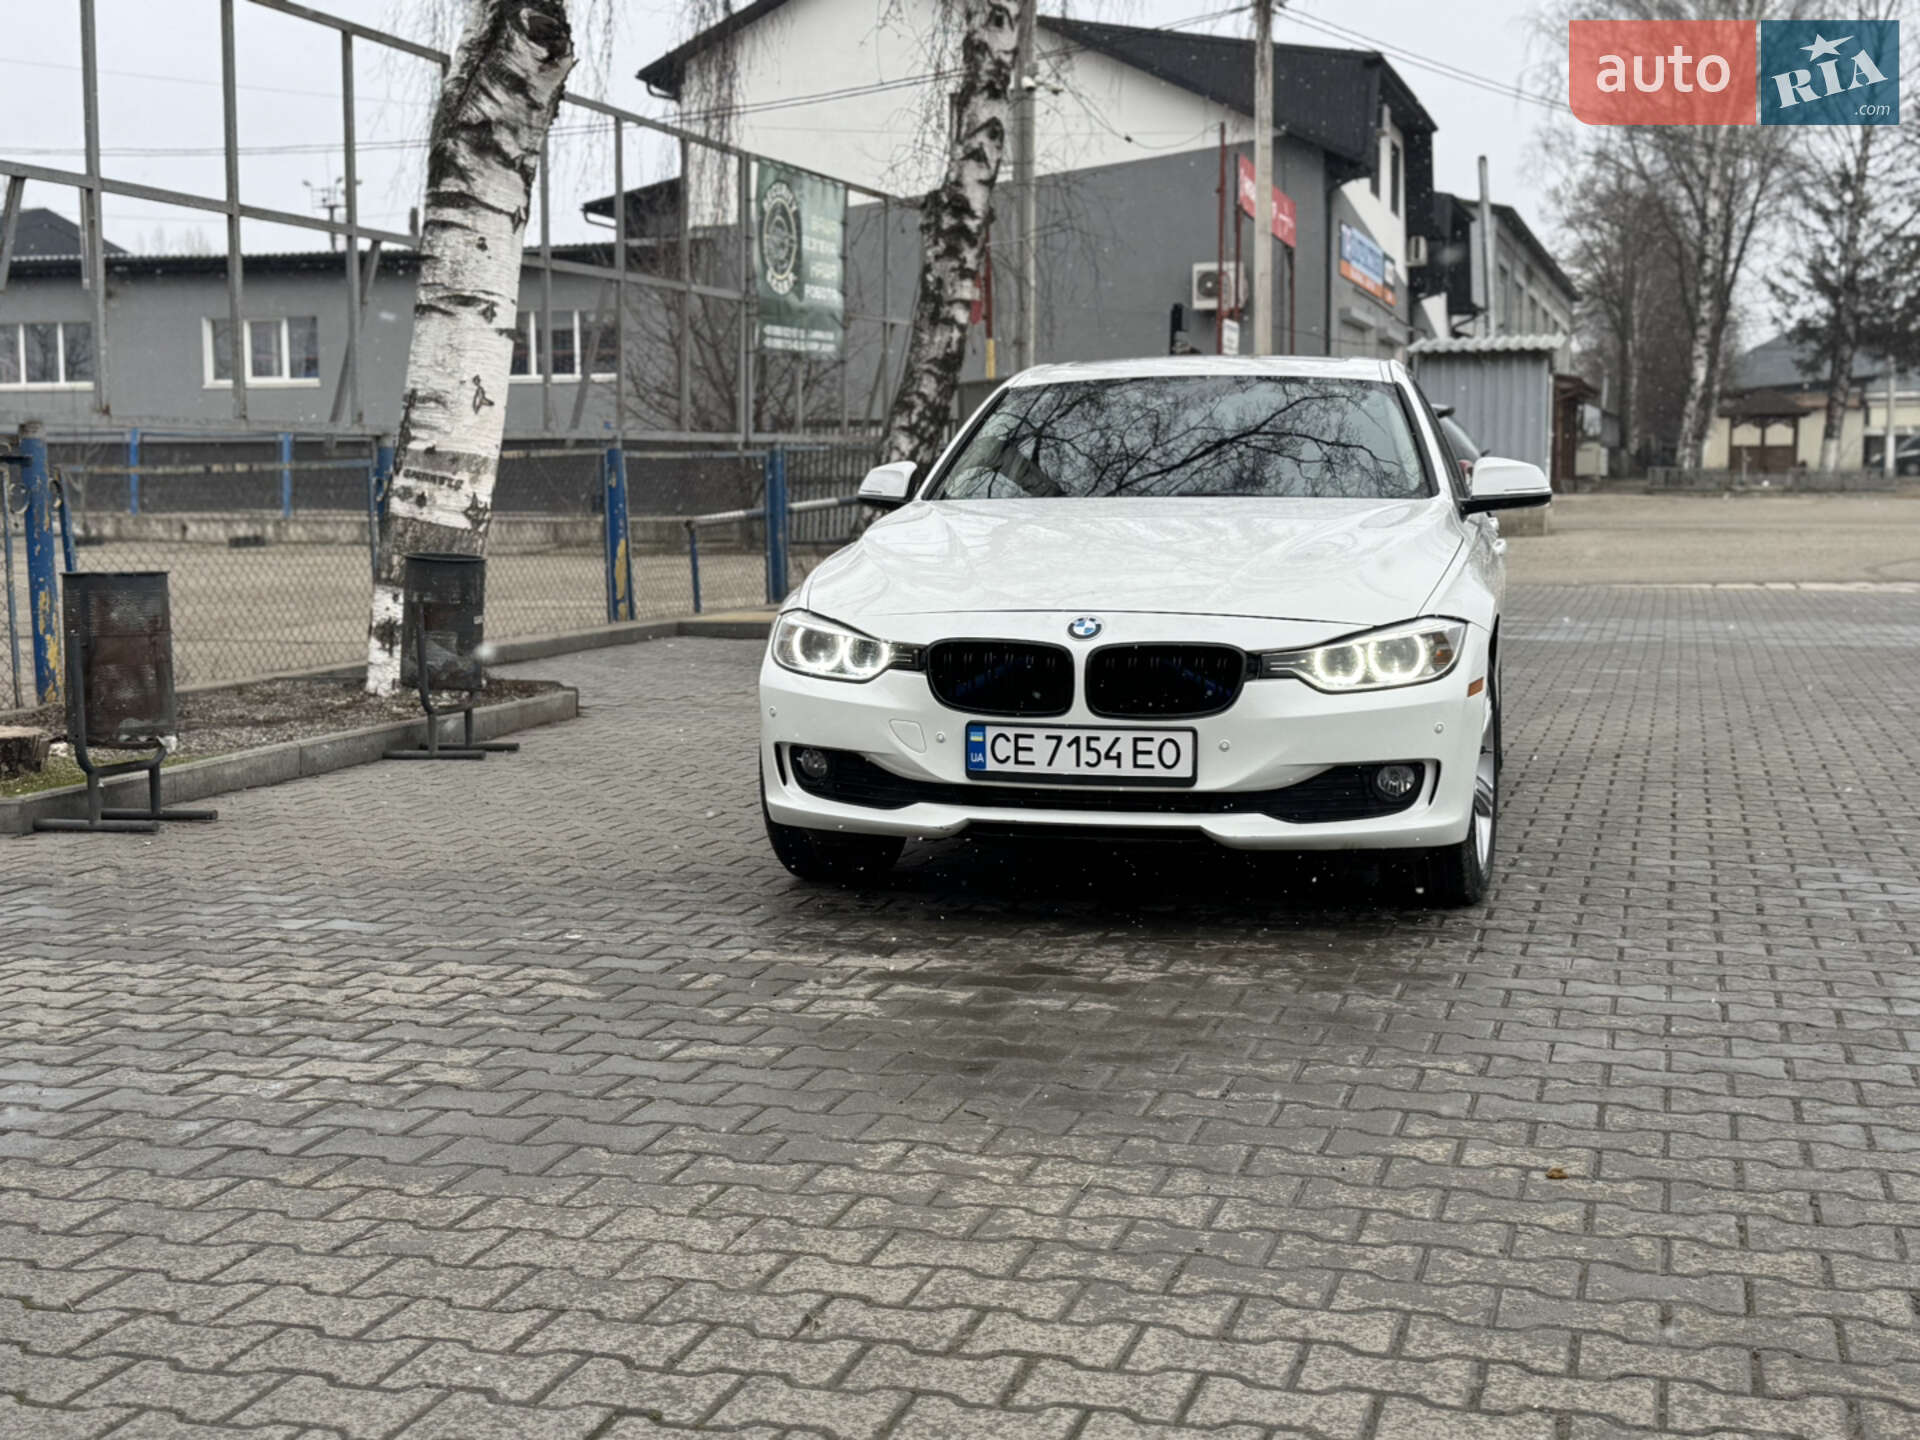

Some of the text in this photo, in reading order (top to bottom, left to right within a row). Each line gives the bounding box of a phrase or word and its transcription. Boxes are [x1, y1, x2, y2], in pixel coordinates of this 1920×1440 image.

[969, 752, 985, 764] UA
[990, 732, 1036, 766] CE
[1045, 734, 1122, 769] 7154
